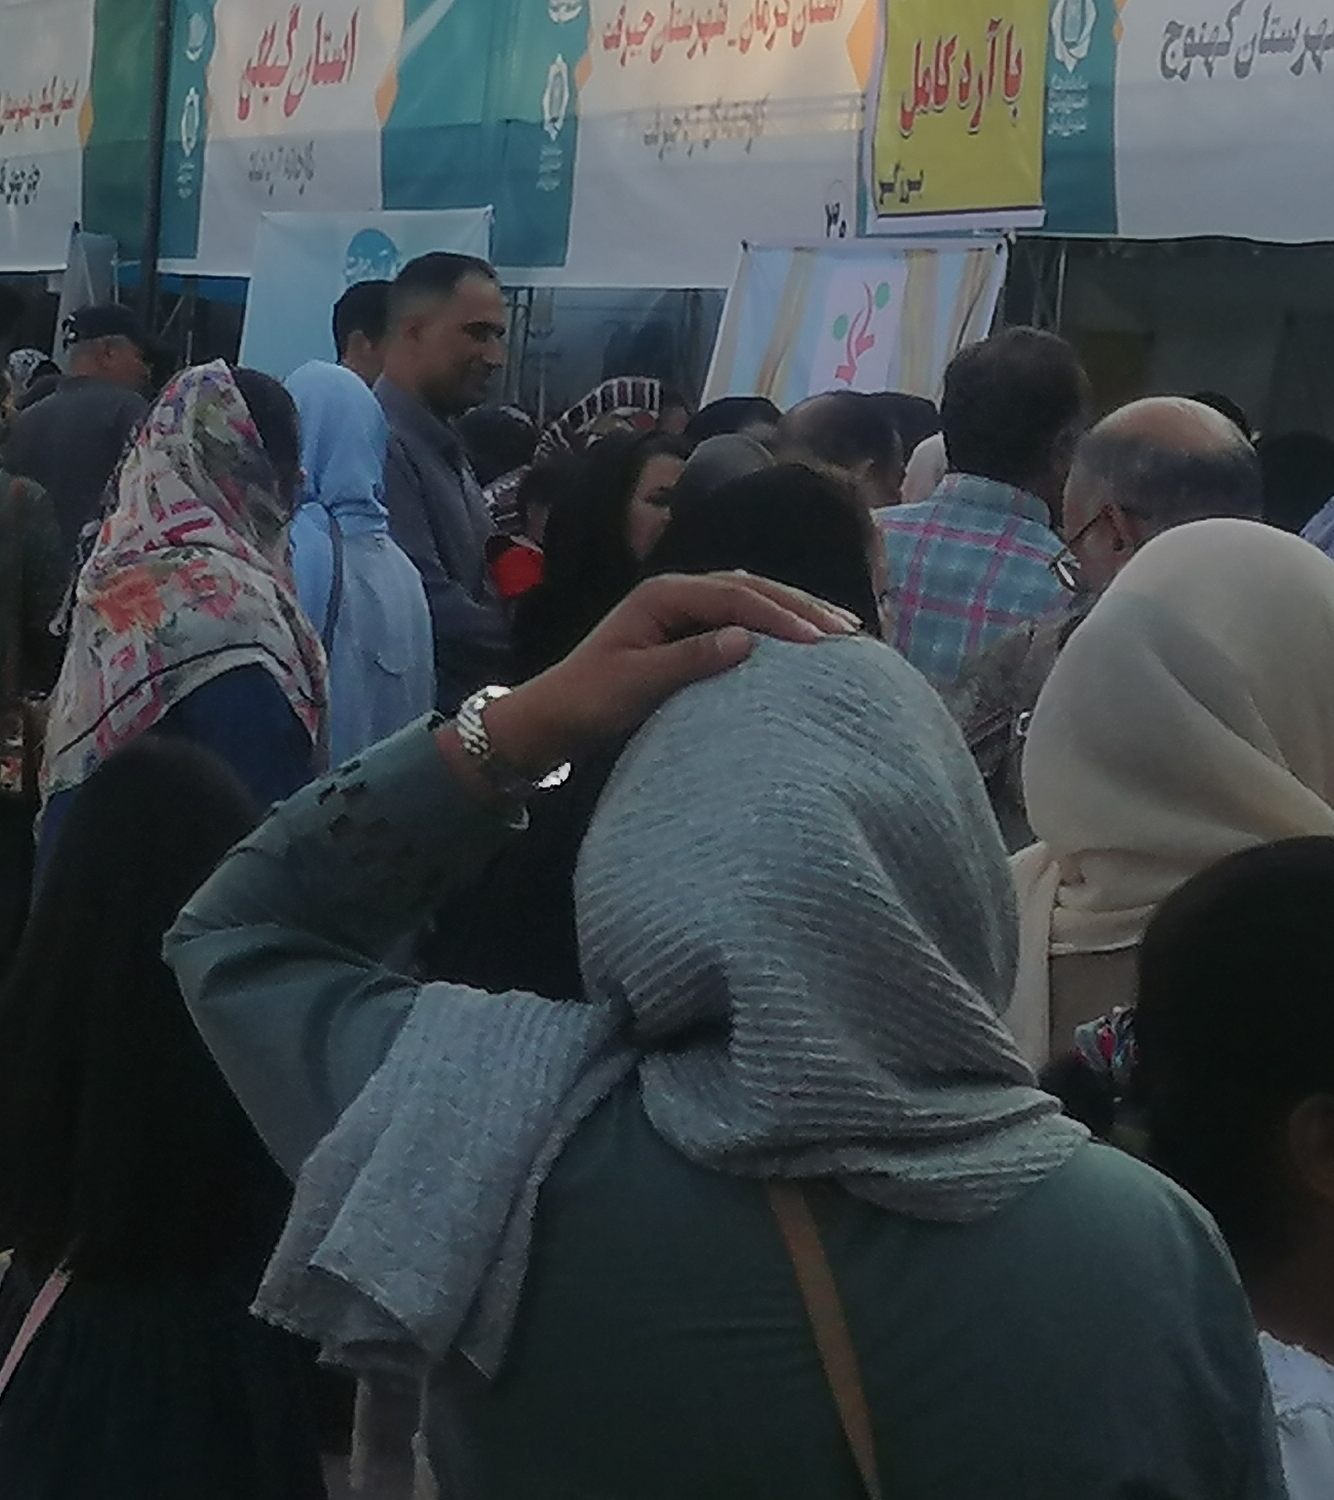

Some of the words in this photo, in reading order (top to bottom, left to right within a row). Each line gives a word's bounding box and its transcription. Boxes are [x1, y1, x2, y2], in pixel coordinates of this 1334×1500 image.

[283, 6, 360, 118] استان
[898, 33, 957, 138] کامل
[958, 15, 1004, 136] آرد
[1003, 22, 1026, 125] با
